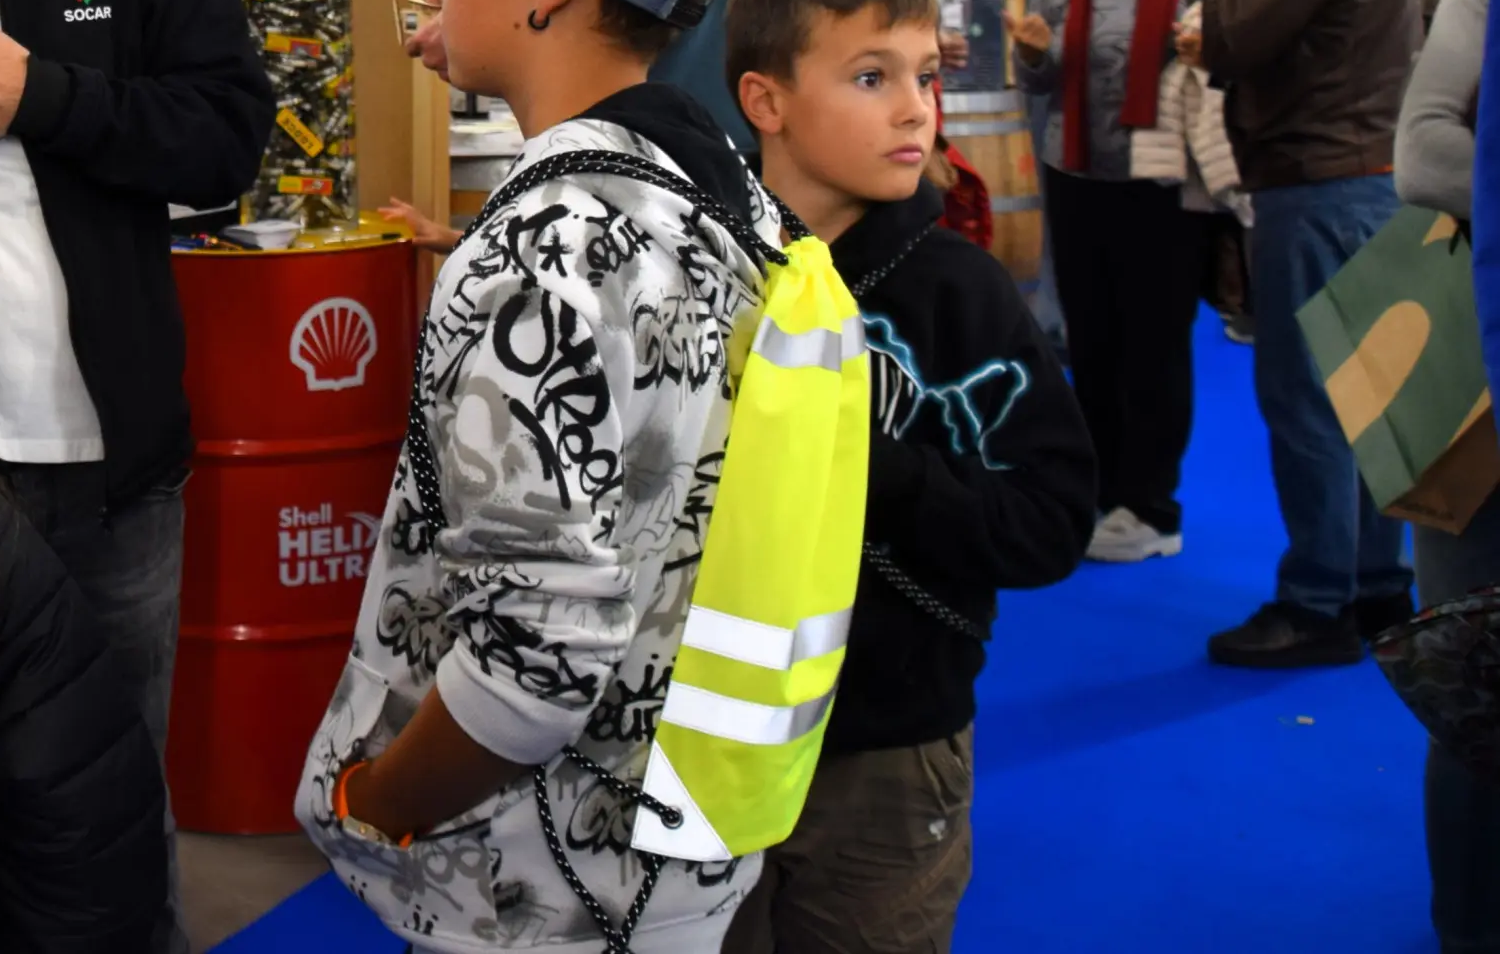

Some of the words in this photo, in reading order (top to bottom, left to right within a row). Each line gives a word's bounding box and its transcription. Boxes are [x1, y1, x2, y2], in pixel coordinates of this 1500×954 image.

[64, 6, 112, 23] SOCAR
[279, 502, 332, 527] Shell
[279, 554, 368, 587] ULTR
